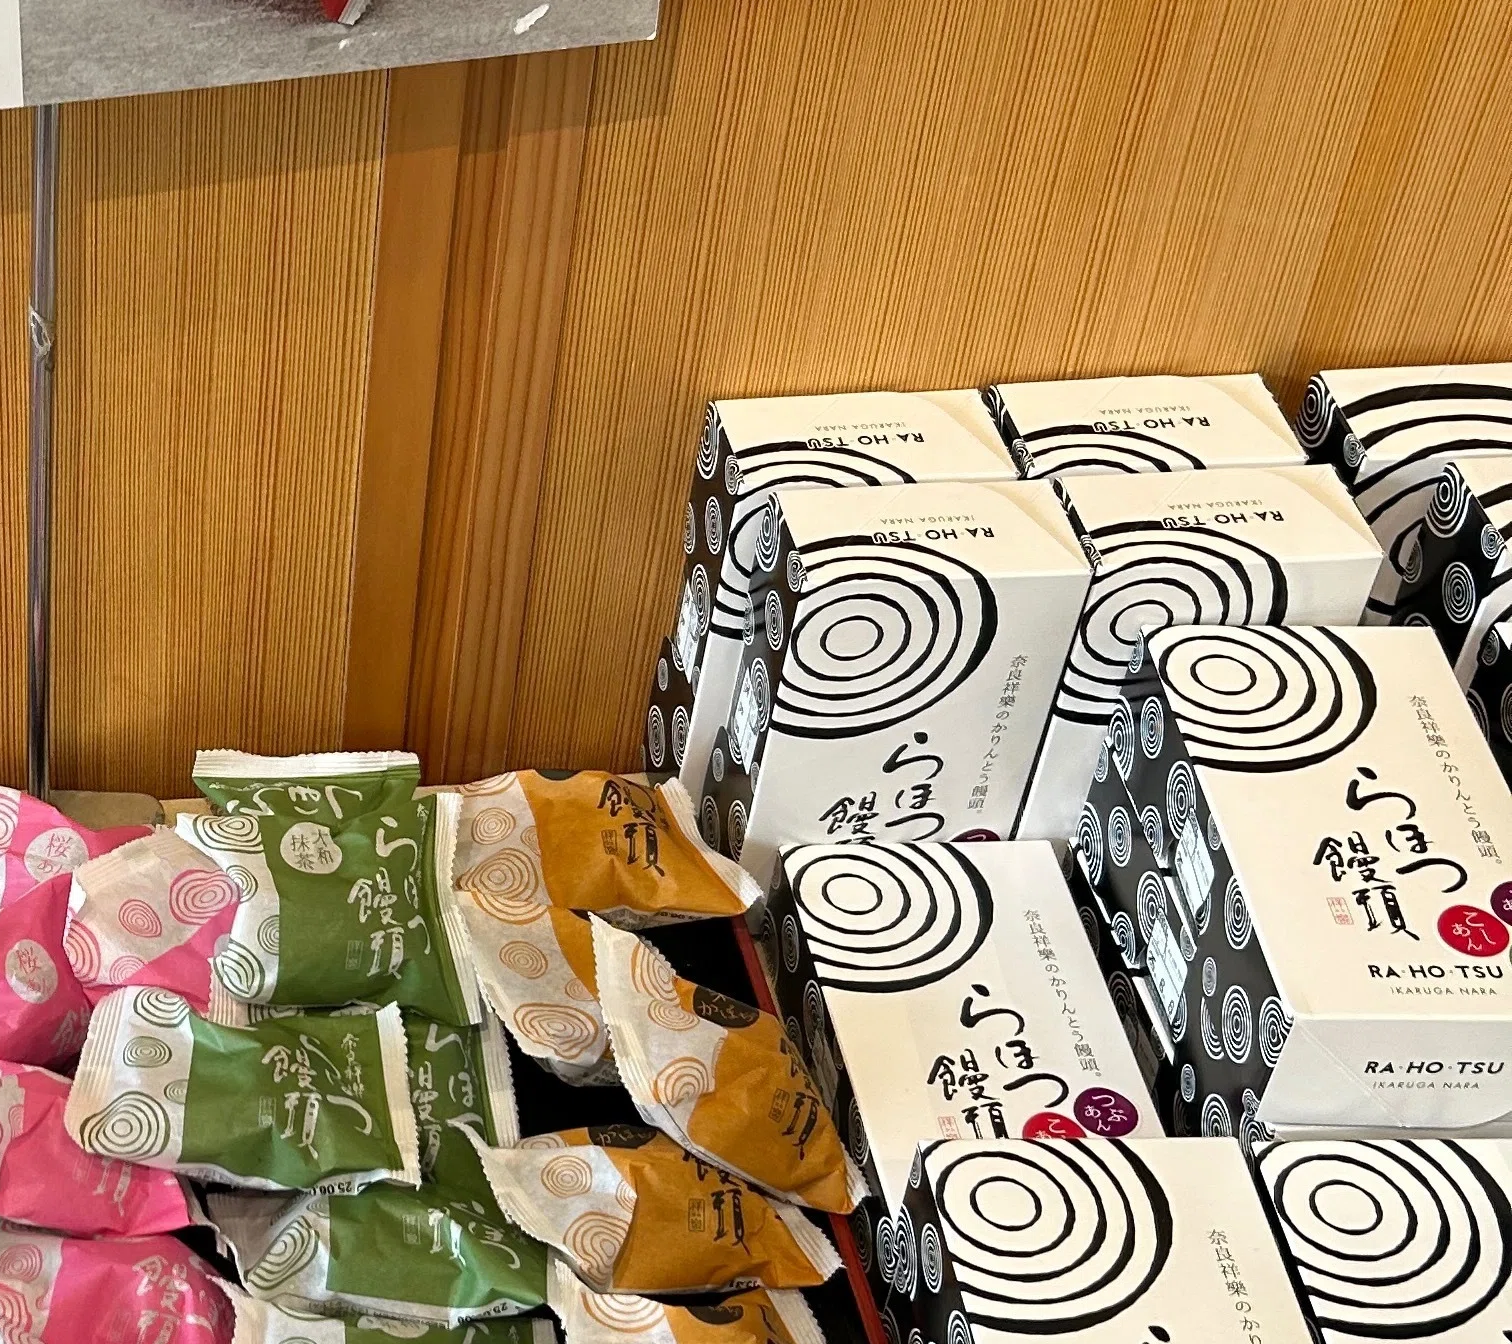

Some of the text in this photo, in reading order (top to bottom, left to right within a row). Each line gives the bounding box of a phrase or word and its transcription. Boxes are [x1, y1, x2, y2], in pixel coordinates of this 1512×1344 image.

[882, 731, 946, 839] らほつ
[1345, 766, 1468, 894] らほつ
[346, 865, 406, 980] 饅頭
[374, 815, 433, 956] らほつ
[1312, 830, 1420, 941] 饅頭
[261, 1044, 324, 1161] 饅頭
[958, 983, 1071, 1109] らほつ
[1083, 1104, 1114, 1134] あん
[1091, 1092, 1129, 1123] つぶ
